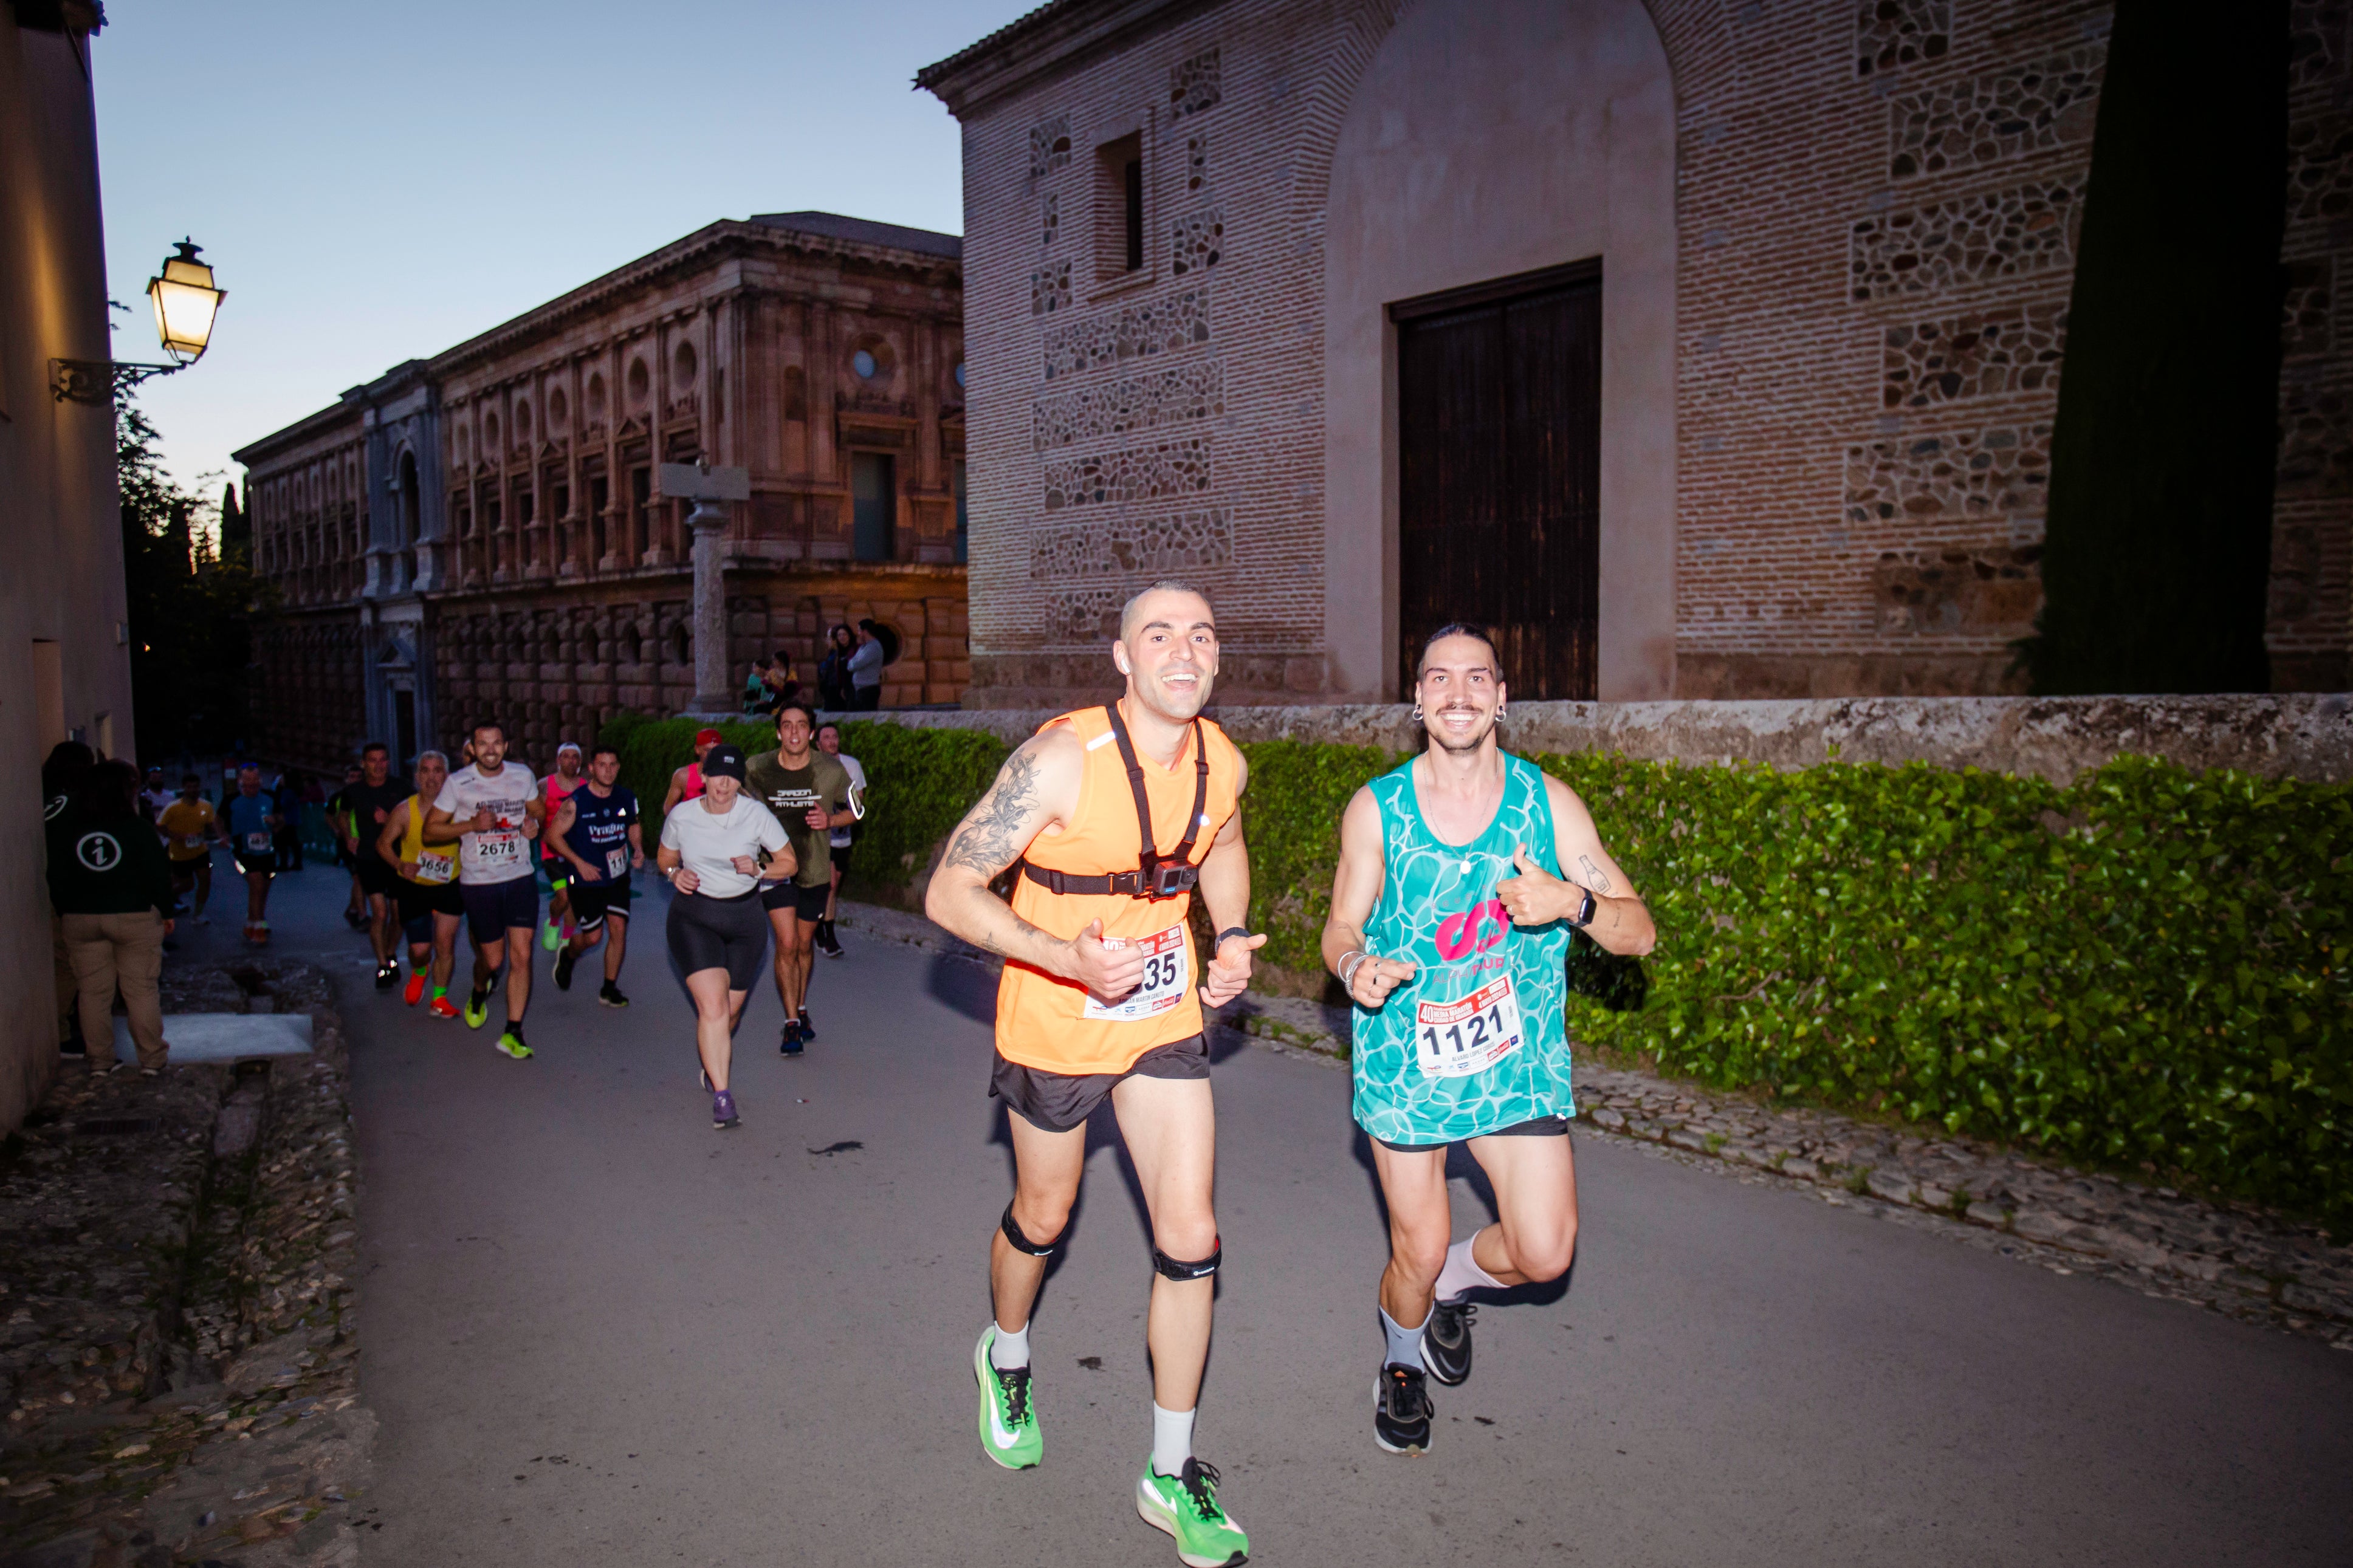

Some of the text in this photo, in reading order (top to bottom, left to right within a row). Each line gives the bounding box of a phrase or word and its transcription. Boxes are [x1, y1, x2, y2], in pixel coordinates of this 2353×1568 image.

[479, 841, 515, 856] 2678
[1420, 1004, 1434, 1023] 40
[1423, 1004, 1503, 1055] 1121
